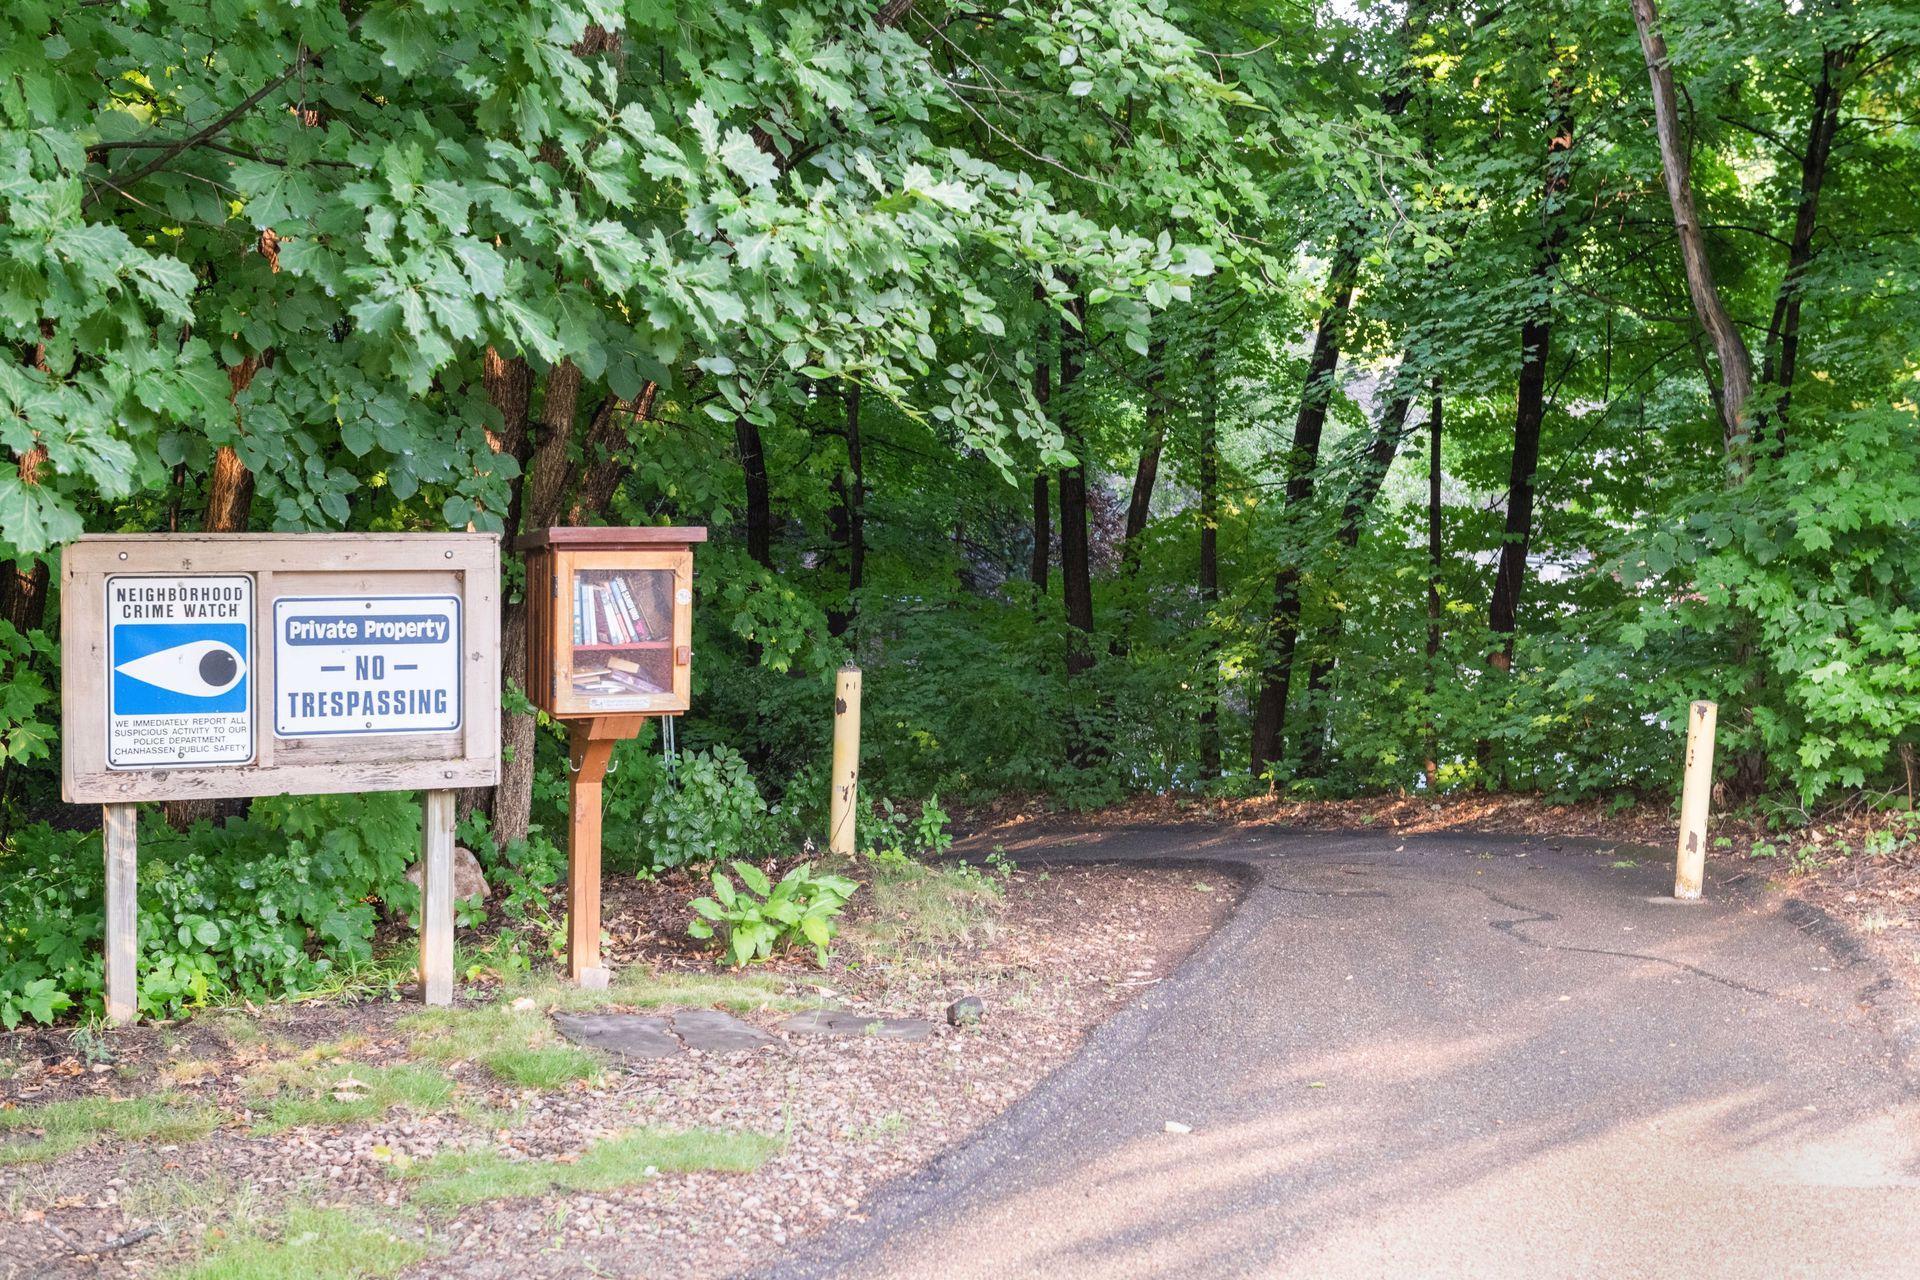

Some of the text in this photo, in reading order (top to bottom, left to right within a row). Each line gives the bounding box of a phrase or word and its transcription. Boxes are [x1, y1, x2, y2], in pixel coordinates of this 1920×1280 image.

[117, 587, 242, 602] NEIGHBORHOOD
[123, 603, 238, 618] CRIME WATCH
[289, 619, 446, 640] Private Property
[356, 655, 385, 680] NO
[288, 689, 447, 718] TRESPASSING
[115, 720, 129, 728] WE
[133, 718, 189, 727] IMMEDIATELY
[231, 717, 246, 725] ALL
[115, 728, 168, 736] SUSPICIOUS
[133, 736, 225, 745] POLICE DEPARTMENT
[115, 744, 246, 755] CHANHASSEN PUBLIC SAFETY
